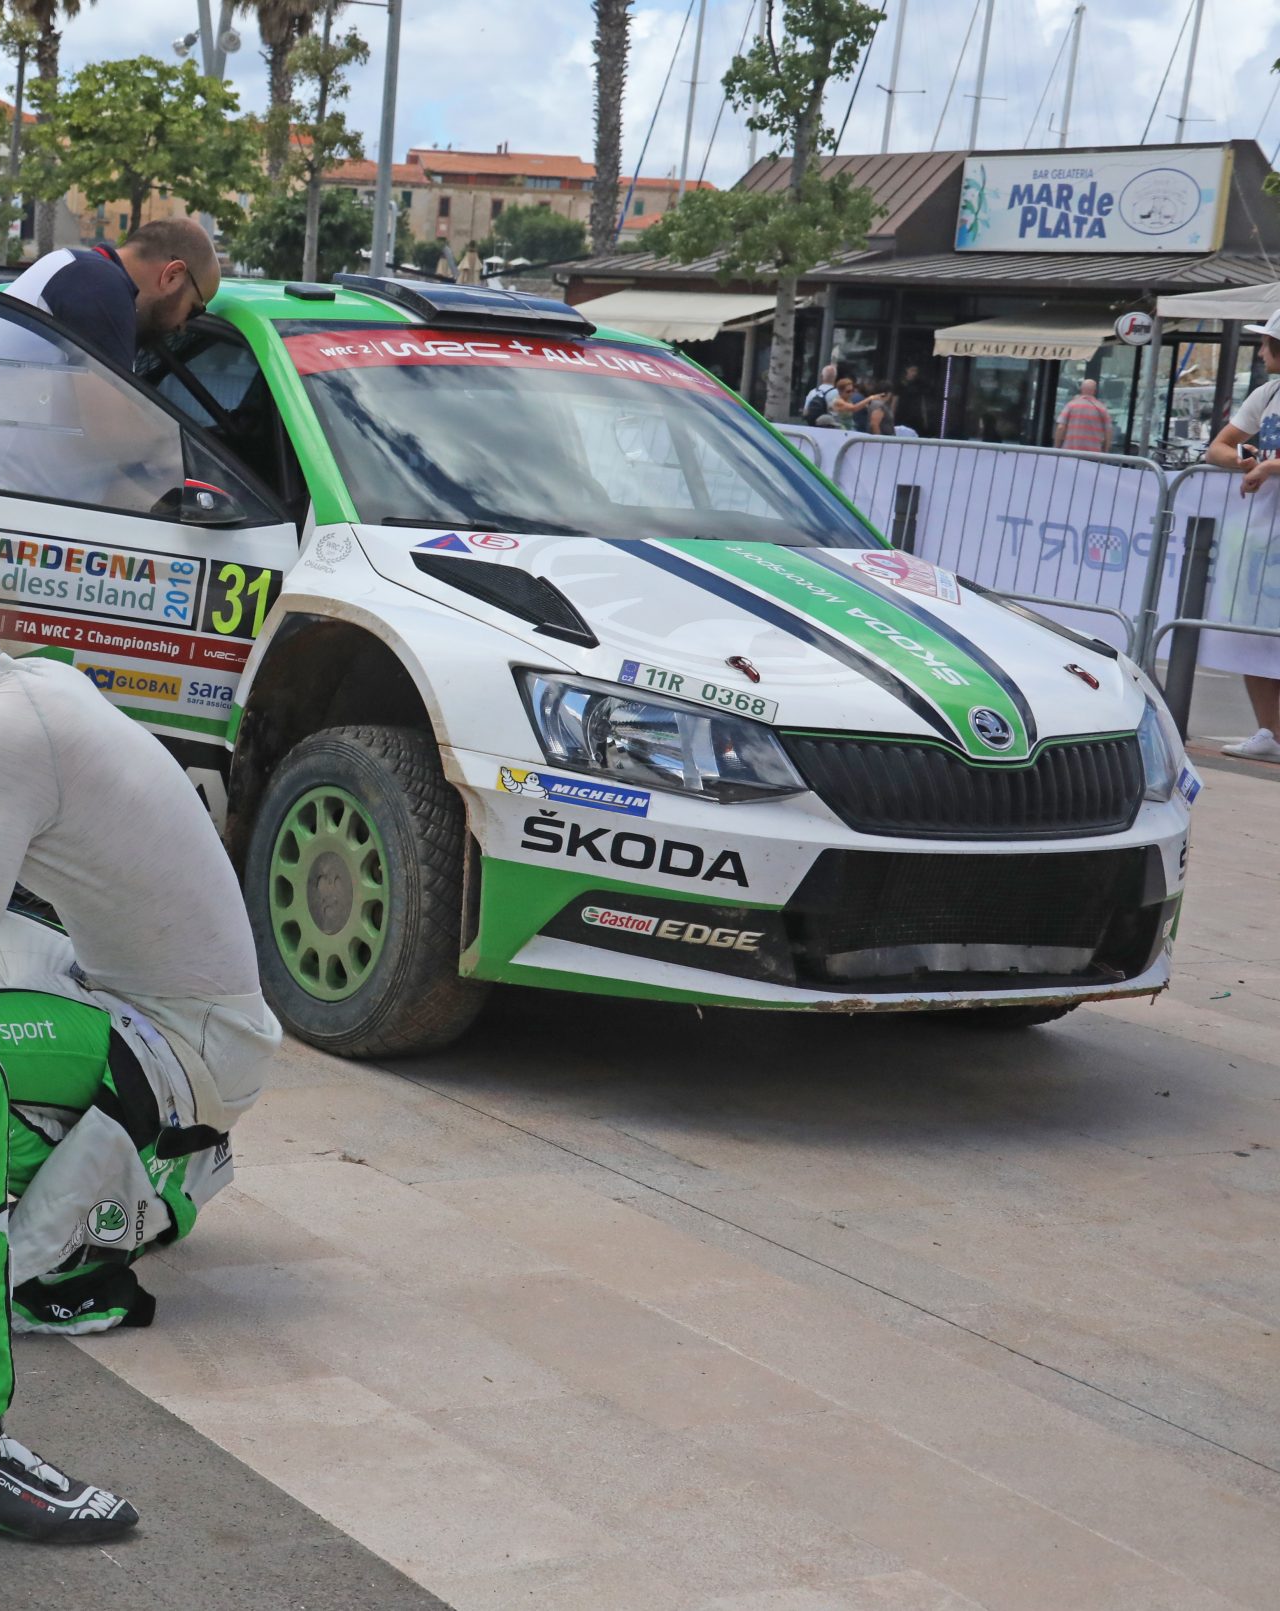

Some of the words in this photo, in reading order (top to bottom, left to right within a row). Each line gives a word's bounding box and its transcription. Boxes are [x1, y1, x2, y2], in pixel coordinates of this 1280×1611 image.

[1032, 169, 1050, 180] BAR
[1051, 168, 1094, 179] GELATERIA
[1008, 184, 1074, 213] MAR
[1077, 181, 1115, 217] de
[1019, 206, 1107, 238] PLATA
[320, 345, 358, 357] WRC
[359, 344, 372, 354] 2
[542, 346, 599, 367] ALL
[596, 354, 662, 378] LIVE
[76, 577, 156, 611] island
[164, 560, 195, 621] 2018
[211, 563, 272, 639] 31
[15, 620, 37, 636] FIA
[41, 624, 71, 640] WRC
[74, 628, 83, 641] 2
[87, 630, 180, 657] Championship
[116, 675, 178, 695] GLOBAL
[187, 697, 204, 705] sara
[188, 681, 233, 702] sara
[621, 674, 633, 682] CZ
[646, 668, 685, 693] 11R
[701, 683, 766, 716] 0368
[551, 783, 649, 808] MICHELIN
[521, 808, 750, 888] ŠKODA
[599, 910, 653, 932] Castrol
[656, 919, 766, 952] EDGE
[47, 1506, 56, 1514] R
[79, 1489, 118, 1519] OMP
